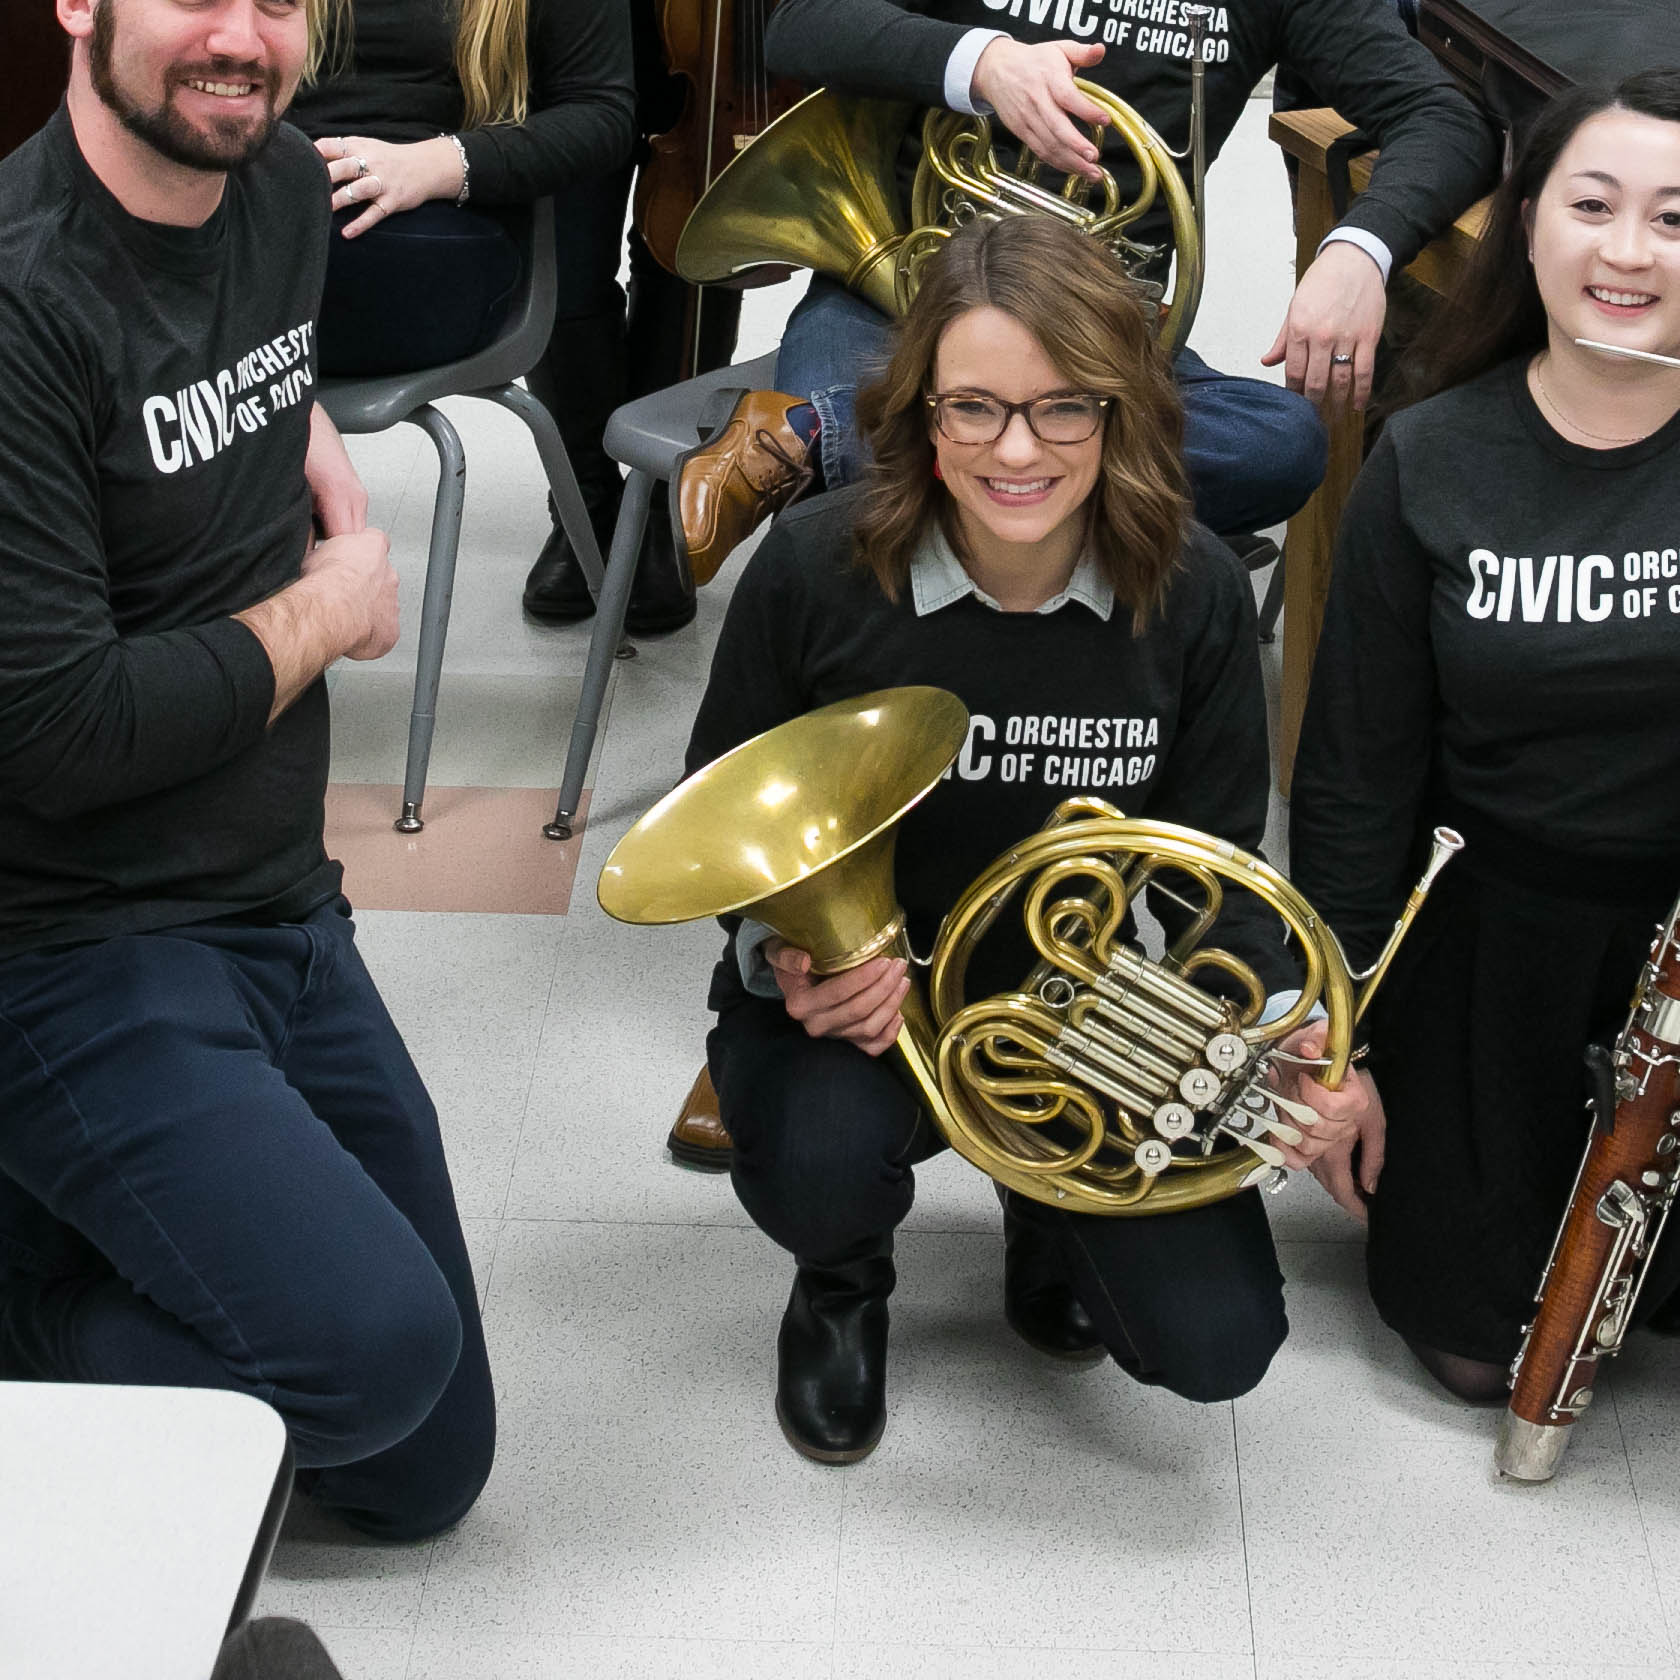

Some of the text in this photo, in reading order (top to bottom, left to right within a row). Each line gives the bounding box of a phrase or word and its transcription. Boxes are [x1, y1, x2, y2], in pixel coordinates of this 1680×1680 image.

[1103, 18, 1229, 63] OF CHICAGO
[236, 320, 313, 393] ORCHEST
[142, 369, 236, 474] CIVIC
[235, 395, 268, 433] OF
[1466, 548, 1615, 623] CIVIC
[1623, 587, 1658, 619] OF
[1005, 716, 1159, 748] ORCHESTRA
[1000, 753, 1156, 787] OF CHICAGO
